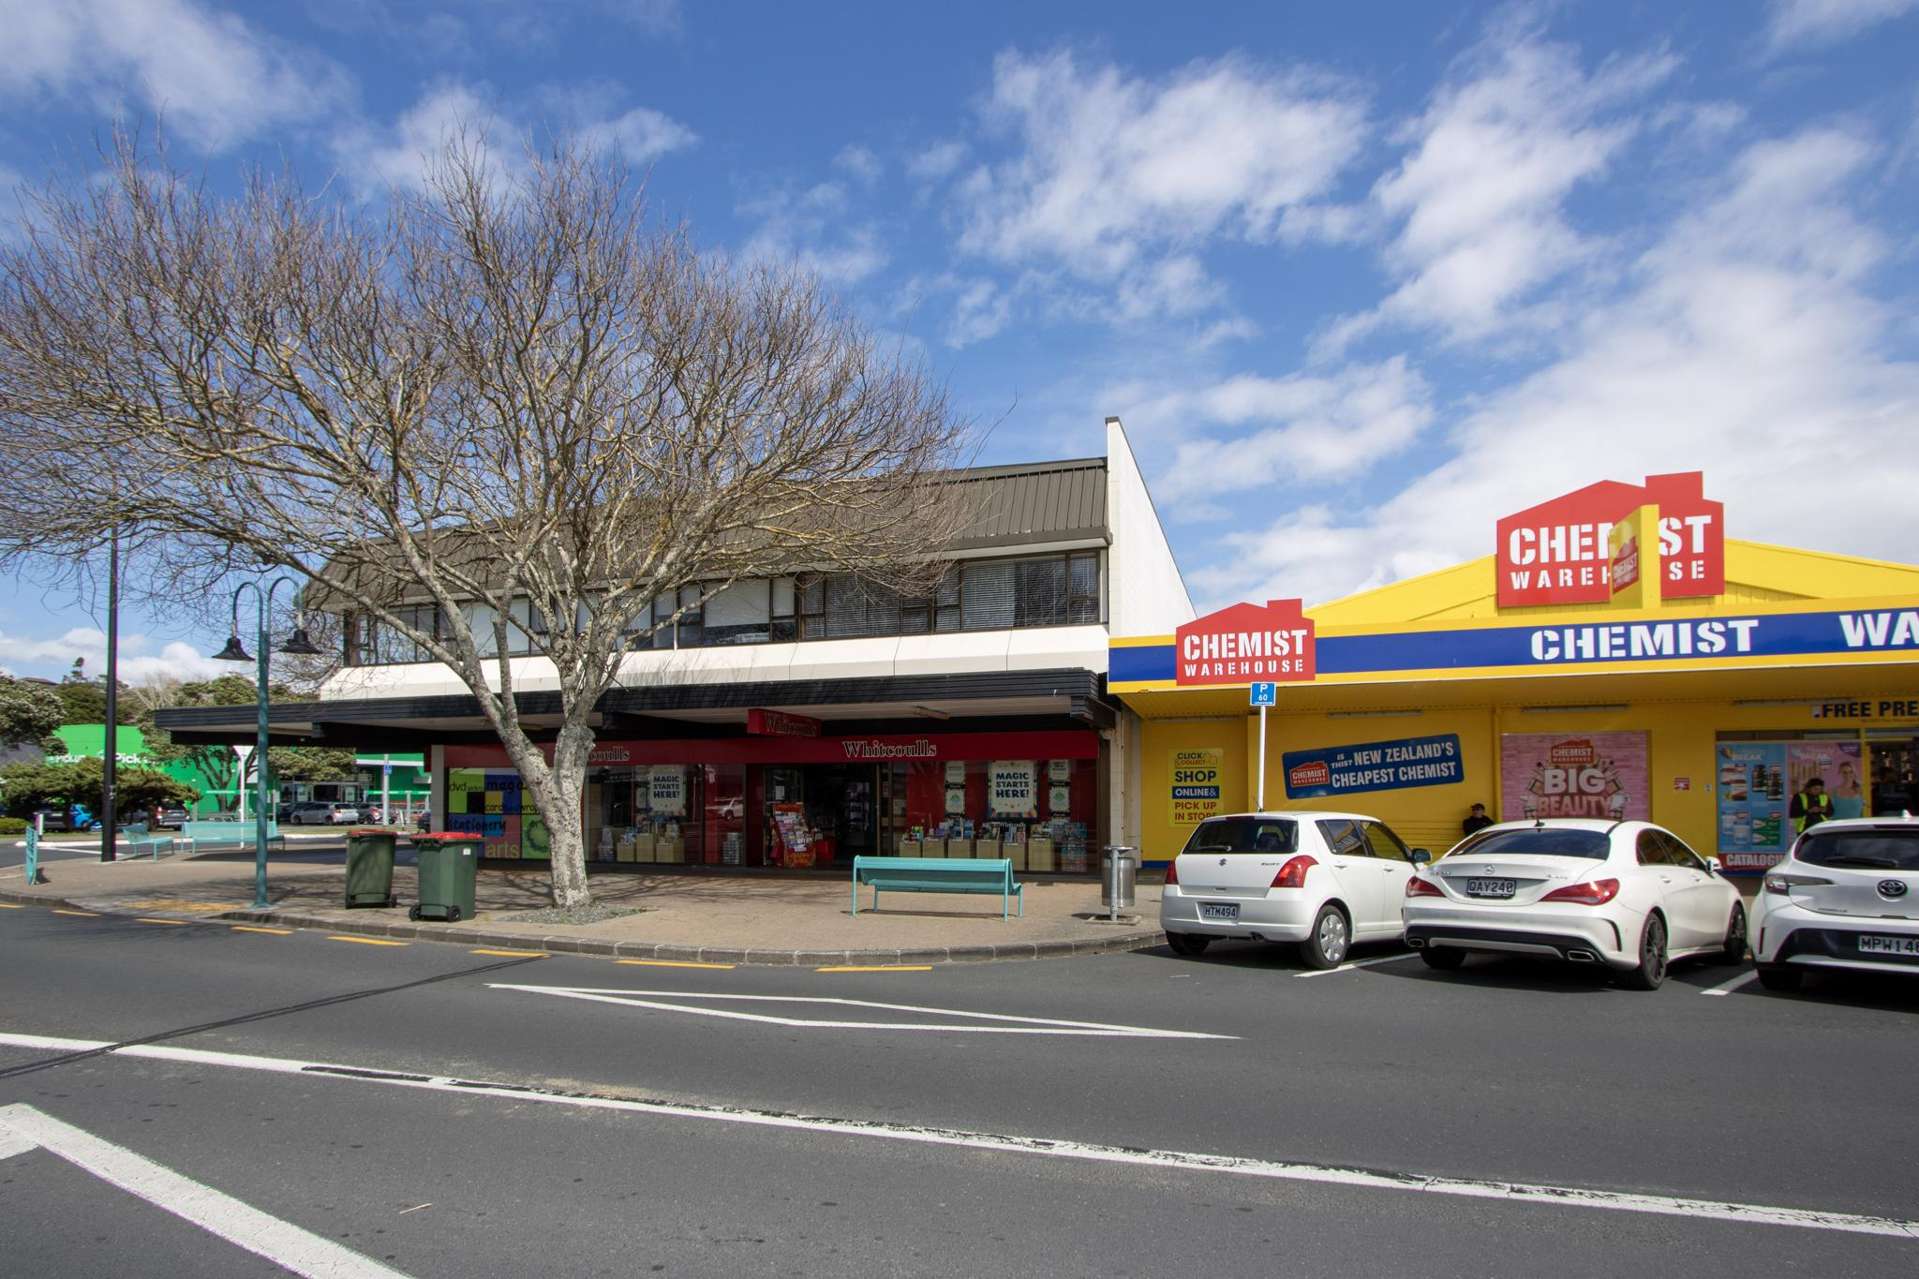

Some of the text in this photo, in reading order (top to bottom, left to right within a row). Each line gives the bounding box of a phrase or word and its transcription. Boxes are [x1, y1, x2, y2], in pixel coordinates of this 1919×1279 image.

[1509, 515, 1712, 565] CHEST
[1509, 560, 1705, 590] WAREHSE
[1184, 629, 1308, 660] CHEMIST
[1530, 618, 1759, 661] CHEMIST
[1184, 660, 1304, 678] WAREHOUSE
[1260, 684, 1269, 693] P
[1258, 694, 1268, 702] 60
[1822, 700, 1919, 718] FREE PRE
[842, 739, 938, 758] Whitcoulls
[1177, 752, 1203, 760] CLICK
[1354, 742, 1455, 766] NEW ZEALAND'S
[653, 775, 681, 783] MAGIC
[996, 772, 1030, 780] MAGIC
[1175, 770, 1217, 782] SHOP
[1331, 762, 1457, 788] CHEAPEST CHEMIST
[1543, 768, 1606, 795] BIG
[996, 789, 1030, 798] HERE!
[1175, 801, 1217, 810] PICK UP
[1537, 795, 1610, 817] BEAUTY
[1175, 812, 1185, 821] IN
[487, 841, 520, 858] arts
[1205, 906, 1236, 917] HTM494
